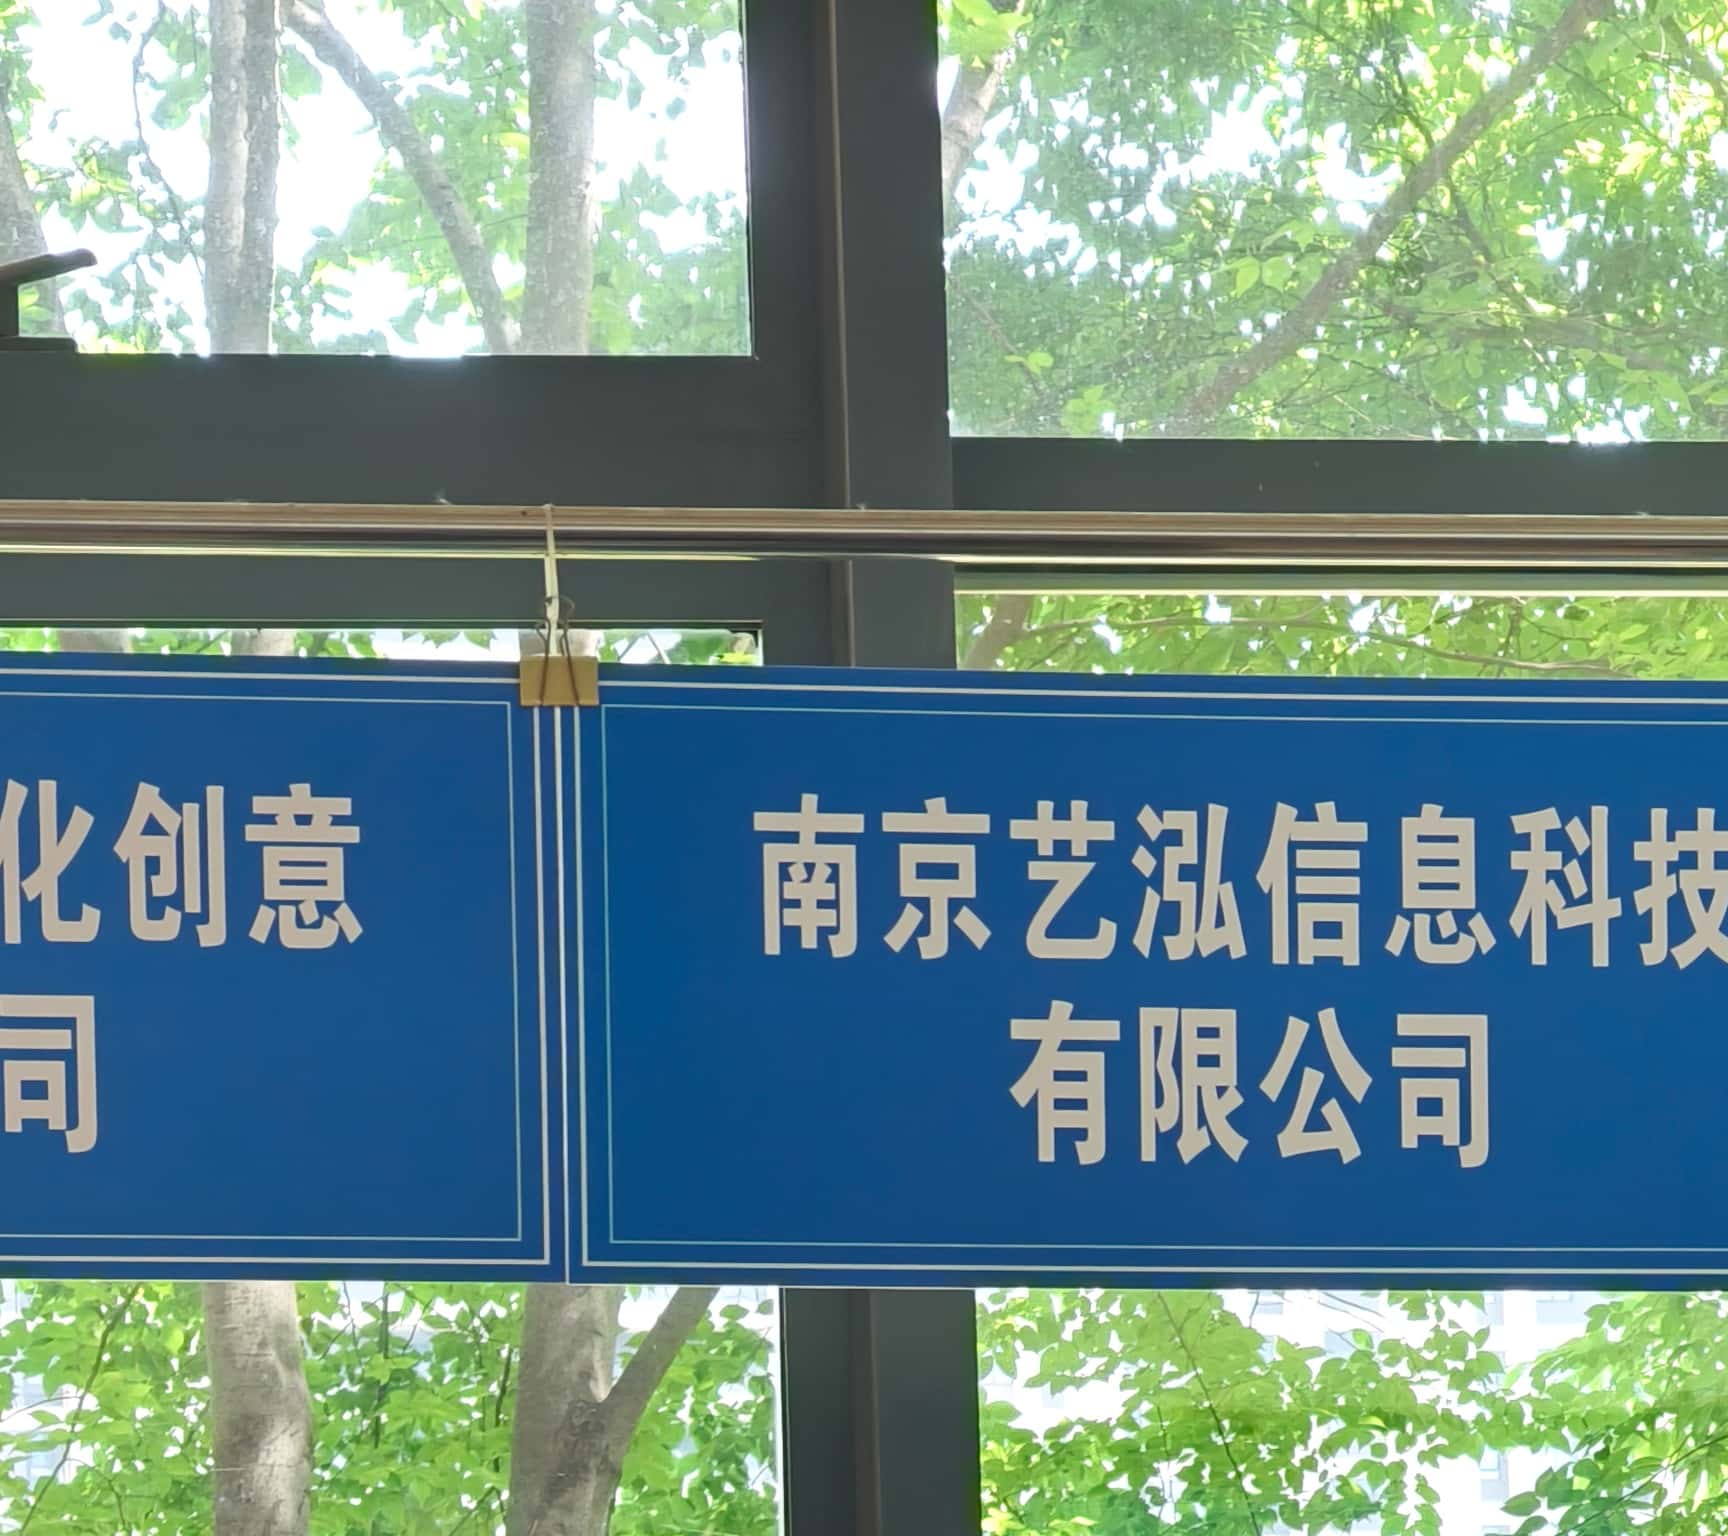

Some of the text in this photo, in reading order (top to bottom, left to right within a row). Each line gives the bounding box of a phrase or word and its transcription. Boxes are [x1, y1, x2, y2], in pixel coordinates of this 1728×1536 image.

[0, 778, 364, 951] 化创意
[0, 994, 98, 1155] 司
[1008, 1000, 1491, 1169] 有限公司
